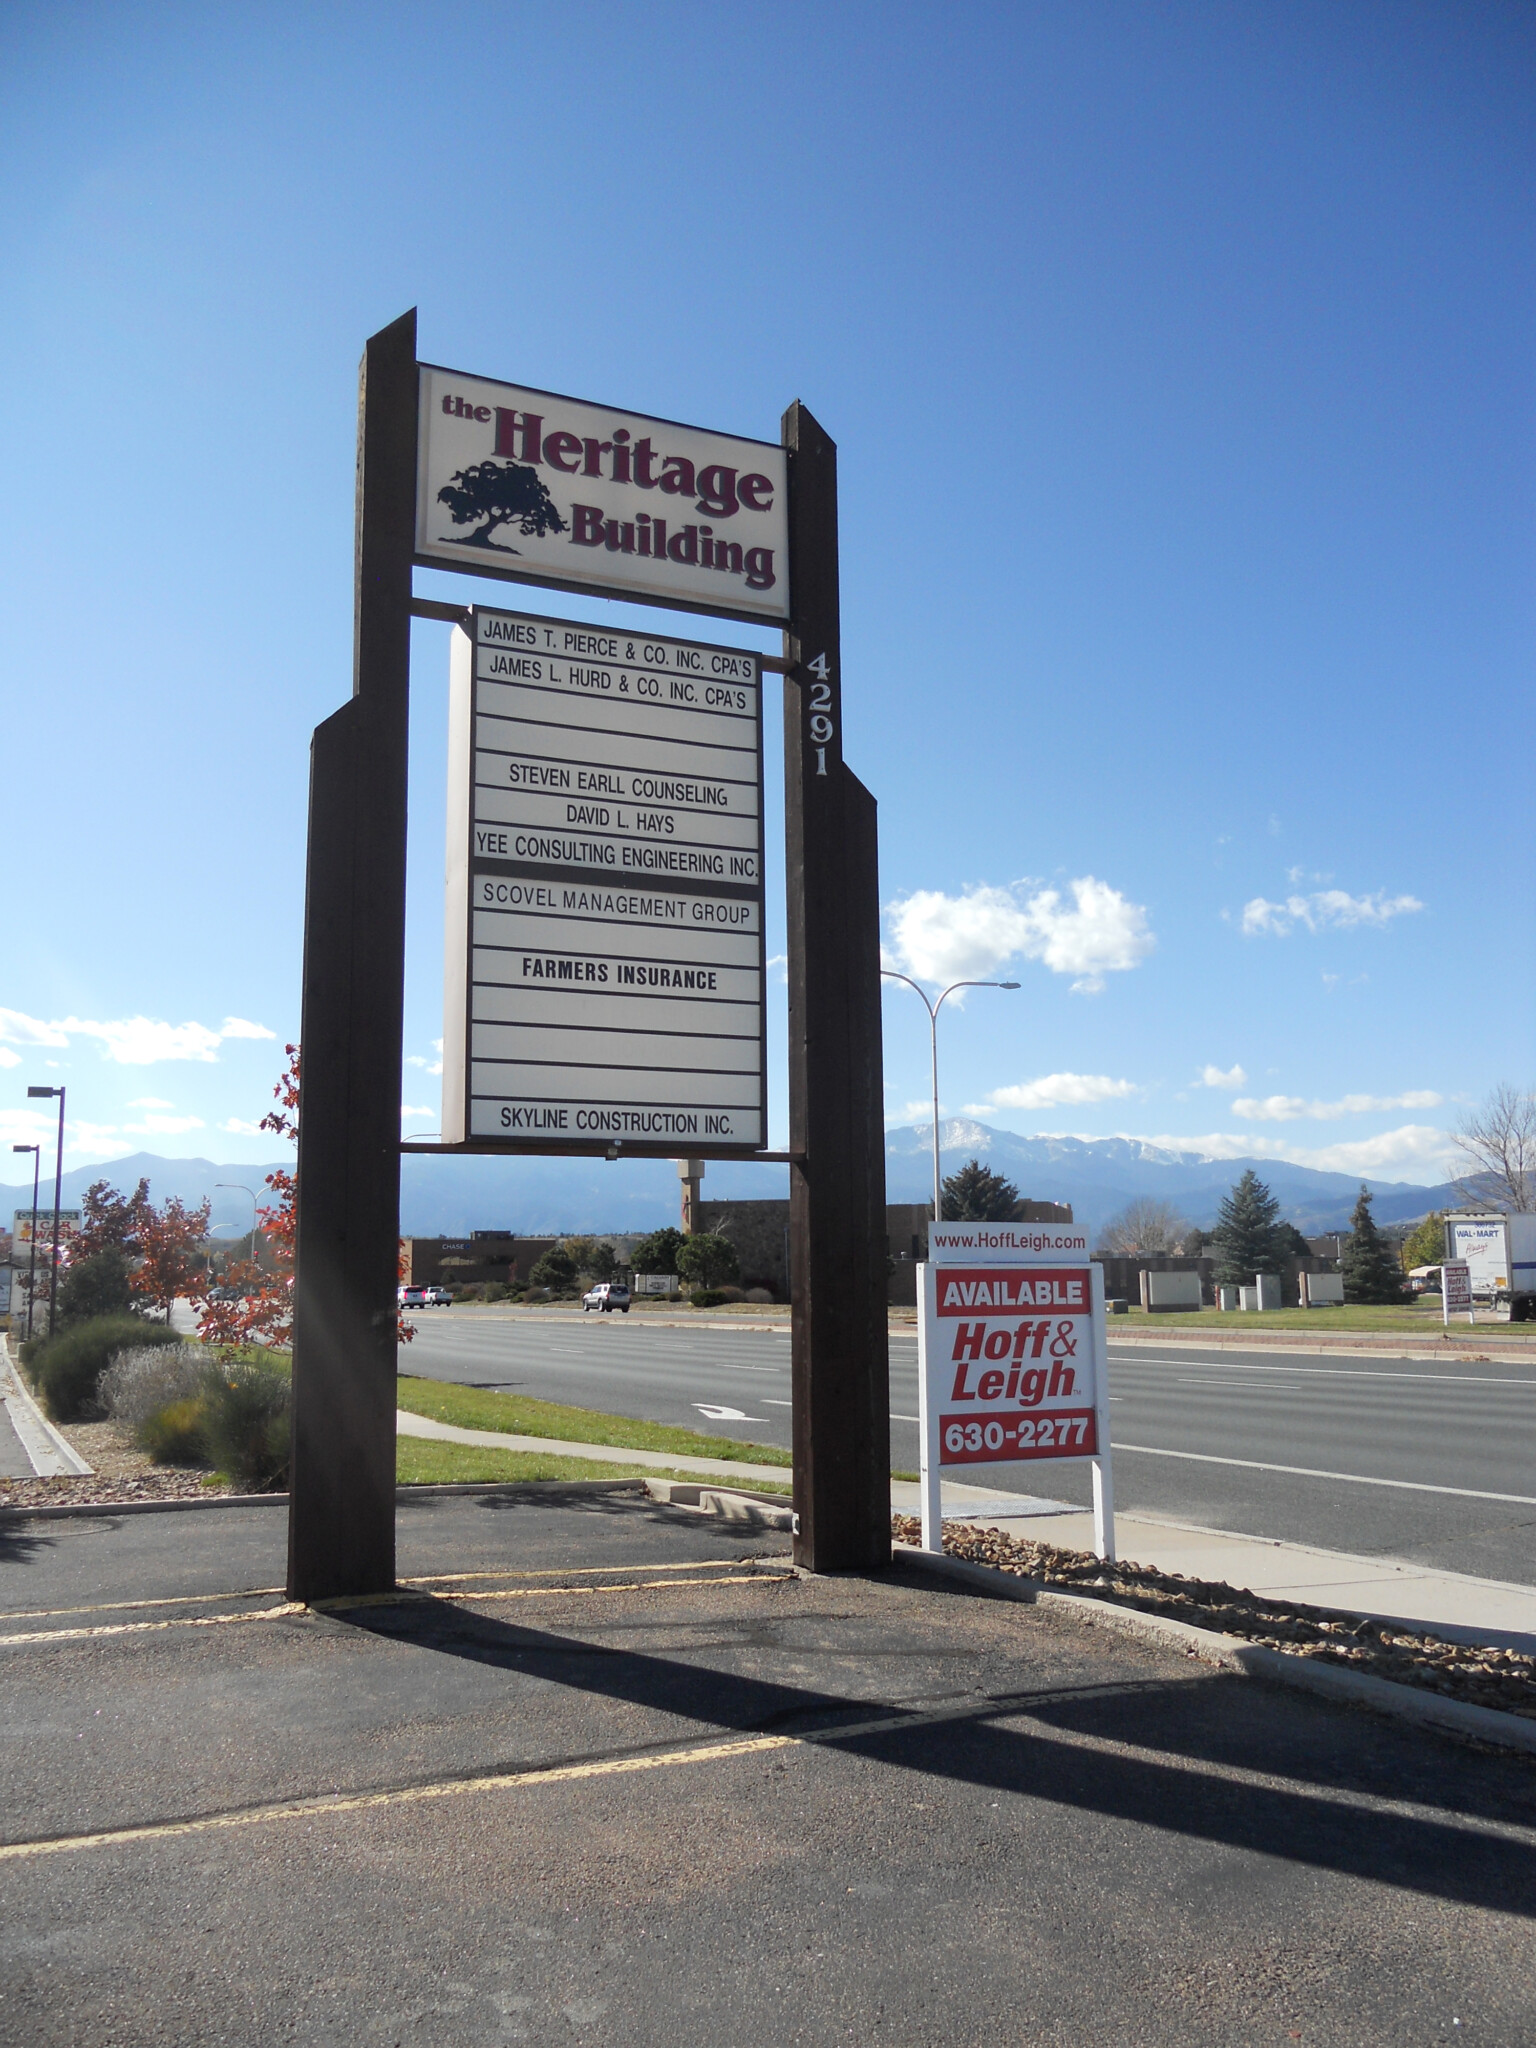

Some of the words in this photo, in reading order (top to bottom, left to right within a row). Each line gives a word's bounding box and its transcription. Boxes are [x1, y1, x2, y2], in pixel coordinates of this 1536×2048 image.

[442, 394, 491, 424] the
[493, 406, 775, 519] Heritage
[568, 503, 777, 591] Building
[484, 620, 536, 645] JAMES
[544, 629, 556, 648] T.
[564, 632, 618, 657] PIERCE
[625, 642, 636, 660] &
[644, 645, 669, 665] CO.
[676, 650, 704, 670] INC.
[711, 656, 752, 678] CPA'S
[490, 655, 542, 680] JAMES
[550, 664, 562, 682] L.
[569, 667, 611, 689] HURD
[619, 675, 629, 693] &
[637, 677, 662, 697] CO.
[670, 682, 698, 703] INC.
[705, 687, 746, 709] CPA'S
[807, 652, 833, 776] 4291
[509, 763, 570, 788] STEVEN
[578, 772, 625, 794] EARLL
[632, 778, 728, 806] COUNSELING
[567, 804, 610, 826] DAVID
[617, 810, 629, 829] L.
[637, 812, 674, 833] HAYS
[477, 831, 507, 854] YEE
[515, 836, 615, 865] CONSULTING
[622, 847, 724, 874] ENGINEERING
[730, 857, 759, 877] INC.
[483, 883, 557, 908] SCOVEL
[563, 890, 686, 919] MANAGEMENT
[692, 902, 750, 924] GROUP
[522, 957, 608, 982] FARMERS
[617, 965, 717, 990] INSURANCE
[501, 1106, 568, 1129] SKYLINE
[576, 1110, 698, 1133] CONSTRUCTION
[704, 1115, 734, 1135] INC.
[40, 1221, 72, 1230] CR
[934, 1231, 1086, 1251] www.HoffLeigh.com
[943, 1280, 1084, 1307] AVAILABLE
[951, 1360, 1075, 1407] Leigh
[945, 1417, 1089, 1453] 630-2277
